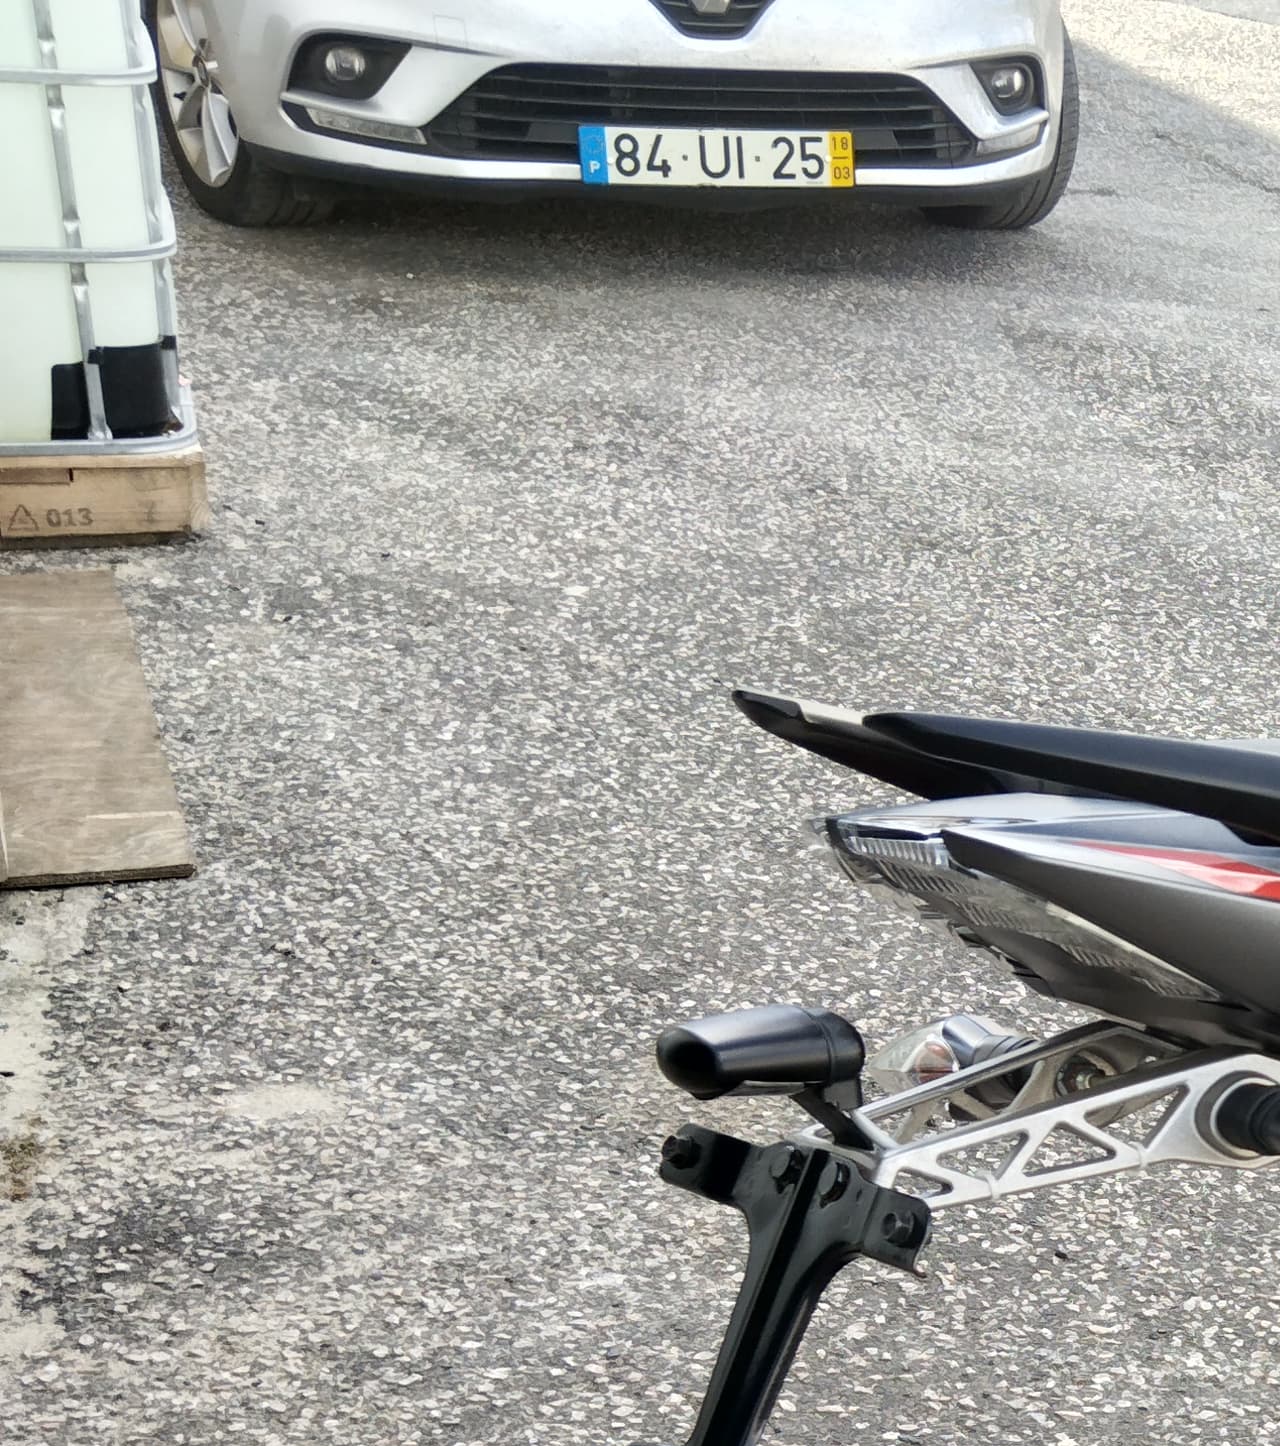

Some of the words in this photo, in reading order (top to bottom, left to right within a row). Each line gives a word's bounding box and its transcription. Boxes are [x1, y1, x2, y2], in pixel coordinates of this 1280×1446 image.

[832, 136, 849, 151] 18
[613, 133, 672, 178] 84
[699, 135, 745, 179] UI
[771, 136, 825, 180] 25
[589, 160, 600, 173] P
[833, 166, 851, 180] 03
[46, 508, 94, 527] 013
